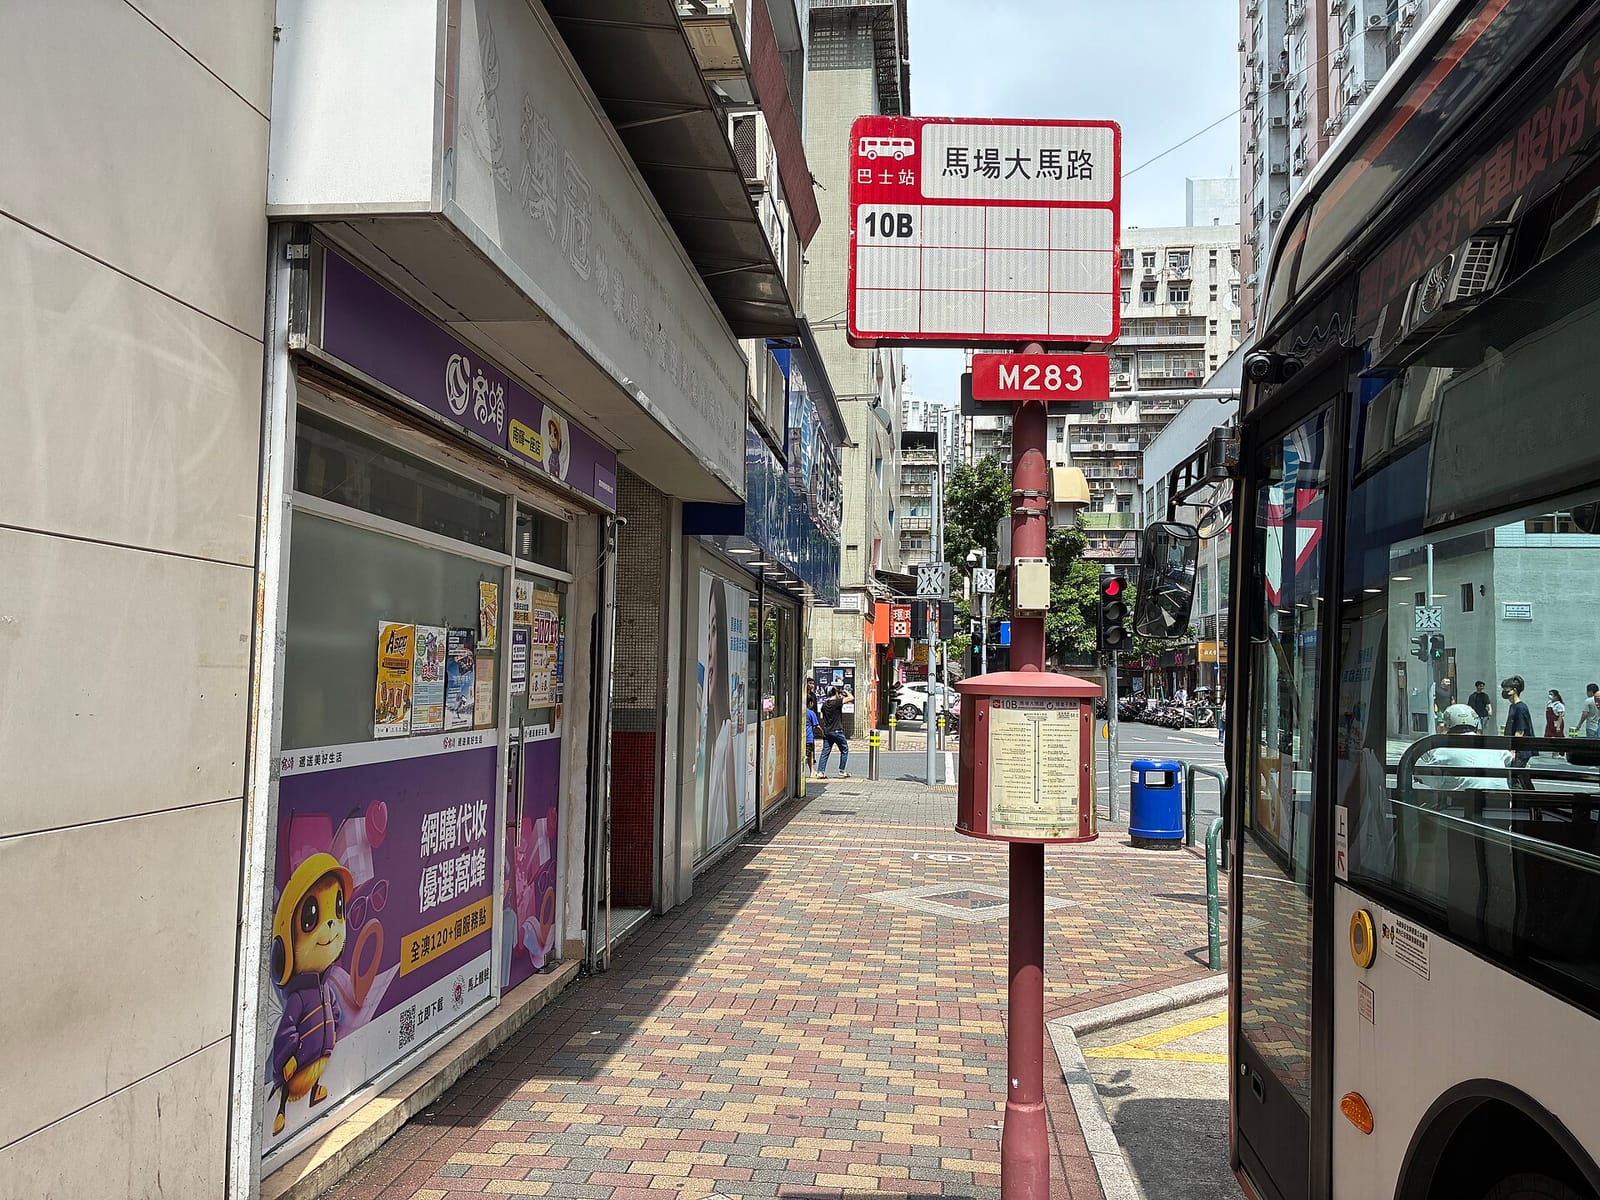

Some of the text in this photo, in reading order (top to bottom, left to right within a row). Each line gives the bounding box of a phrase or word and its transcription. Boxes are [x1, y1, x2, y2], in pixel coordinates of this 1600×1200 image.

[857, 168, 915, 186] 巴士站
[942, 147, 1094, 181] 馬場大馬路
[865, 212, 913, 238] 10B
[998, 365, 1083, 391] M283
[1001, 700, 1018, 709] 10B
[420, 799, 488, 859] 網購代收
[1337, 814, 1346, 838] 上
[419, 847, 487, 913] 優選窩蜂
[410, 905, 487, 962] 全澳120+個服務點
[416, 996, 444, 1026] 立即下載
